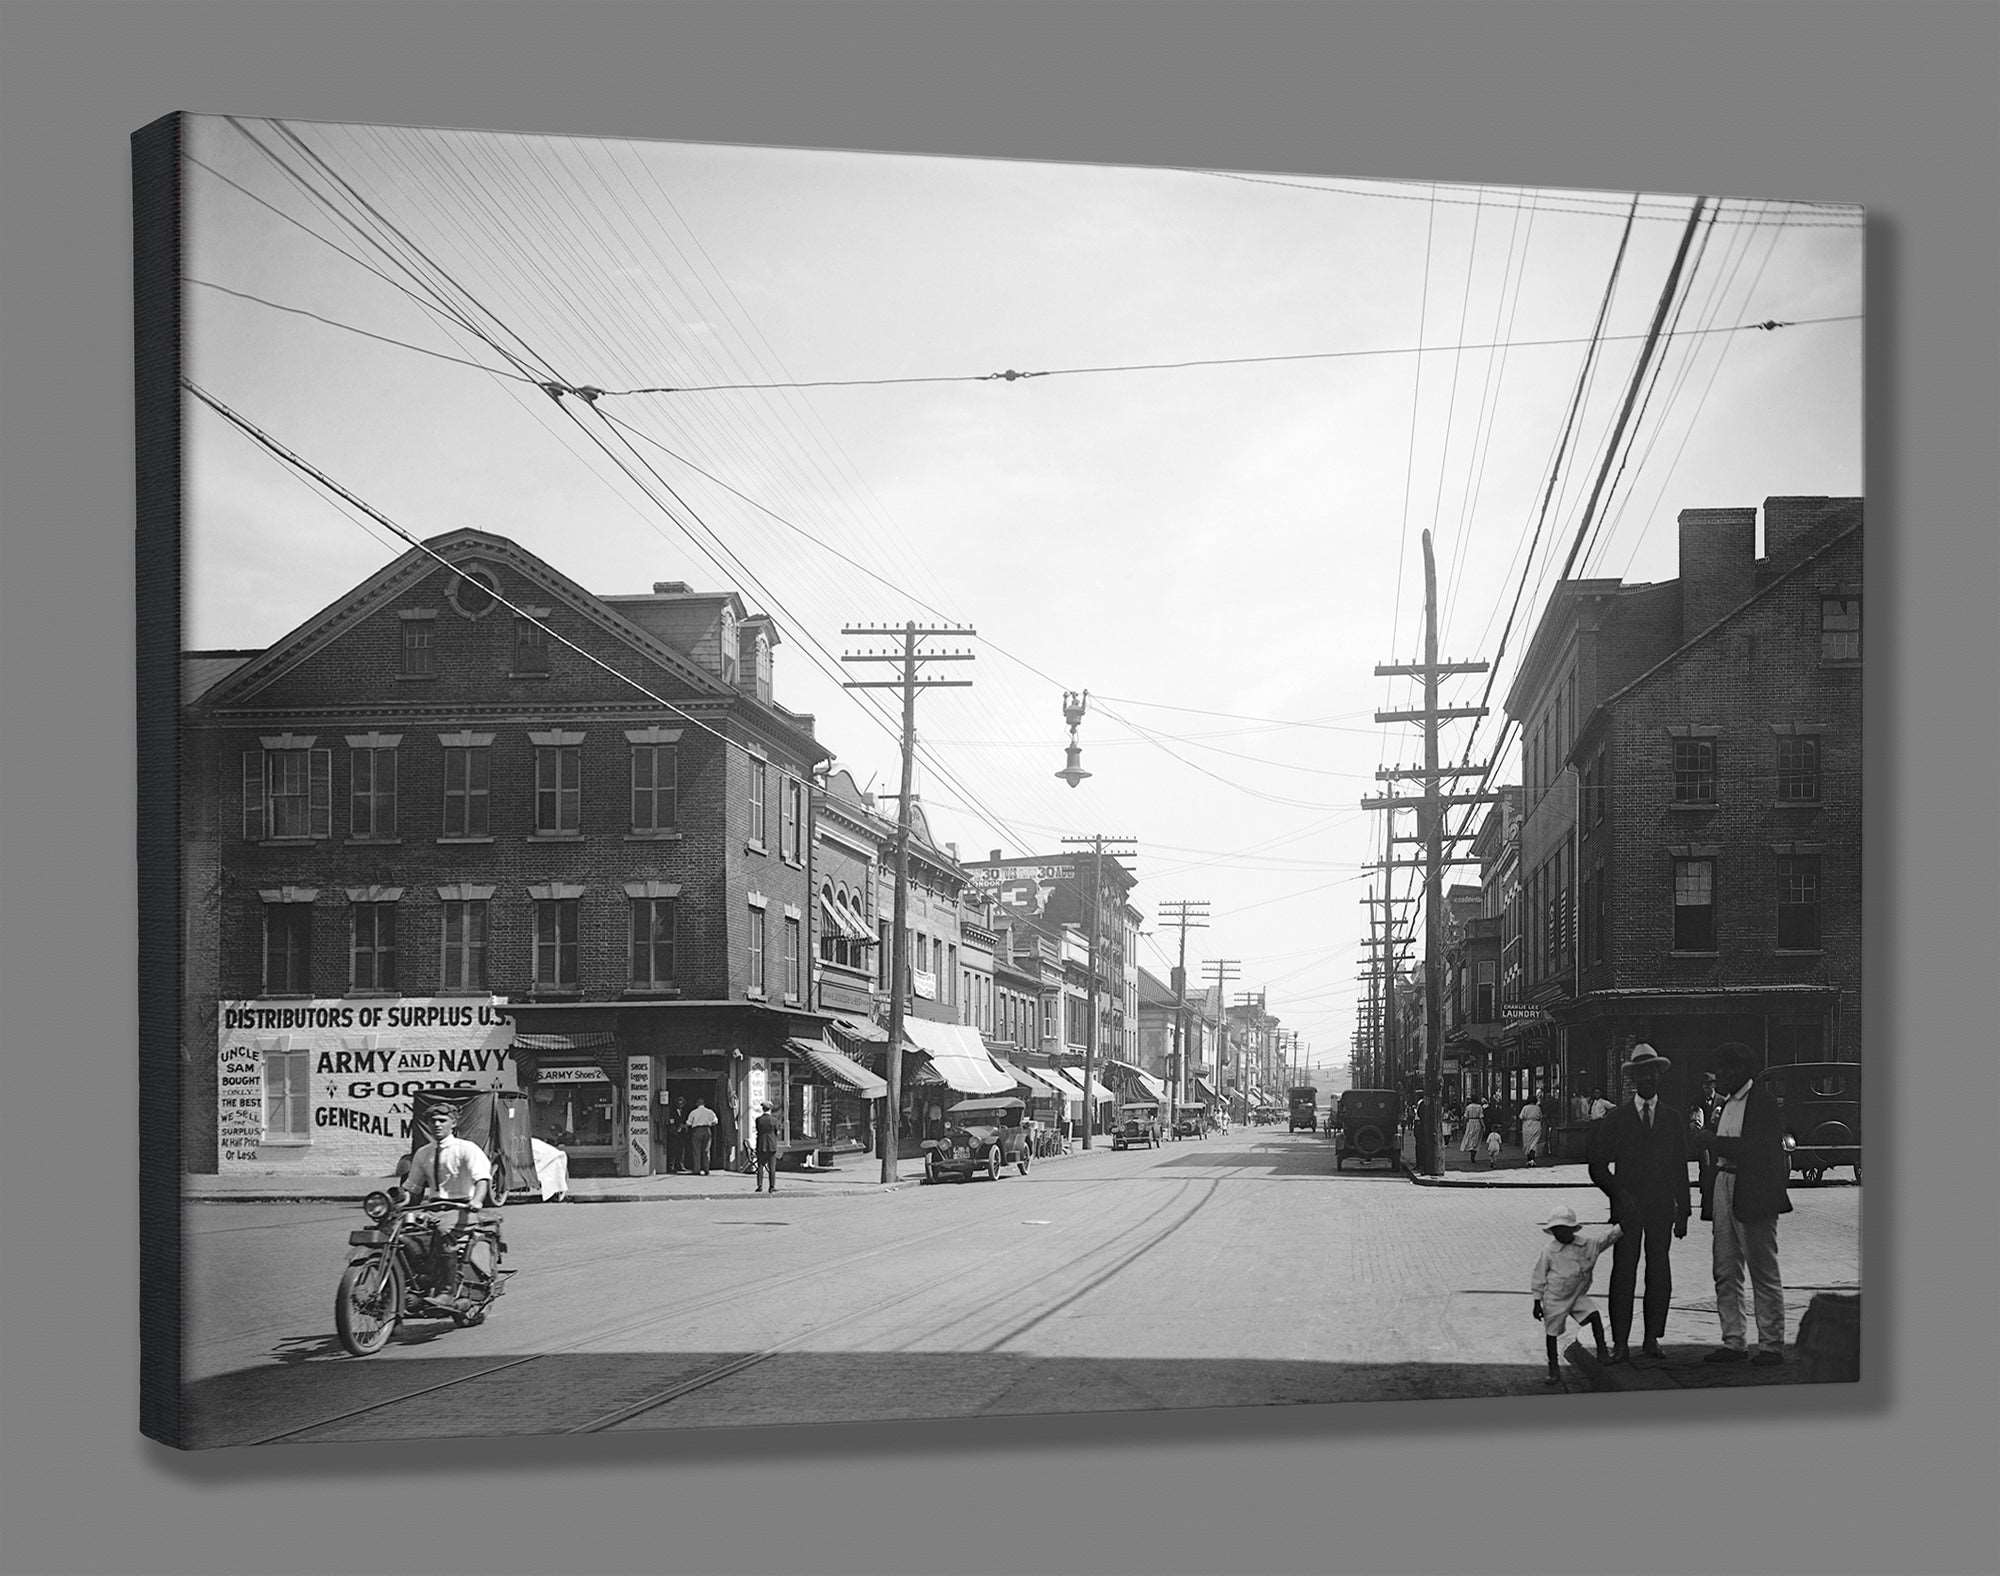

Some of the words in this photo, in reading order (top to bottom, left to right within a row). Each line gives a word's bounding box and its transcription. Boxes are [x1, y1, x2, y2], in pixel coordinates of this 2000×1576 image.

[1037, 866, 1055, 878] 30
[225, 1007, 354, 1029] DISTRIBUTORS
[359, 1007, 382, 1028] OF
[387, 1006, 473, 1027] SURPLUS
[478, 1005, 512, 1026] U.S.
[1502, 1010, 1541, 1018] LAUNDRY
[221, 1046, 260, 1062] UNCLE
[317, 1051, 396, 1073] ARMY
[398, 1053, 435, 1069] AND
[438, 1049, 509, 1072] NAVY
[226, 1063, 255, 1073] SAM
[222, 1076, 260, 1086] BOUGHT
[221, 1098, 237, 1107] THE
[239, 1098, 262, 1107] BEST
[388, 1103, 414, 1114] AN
[221, 1112, 234, 1122] WE
[236, 1109, 260, 1123] SELL
[315, 1106, 394, 1138] GENERAL
[225, 1150, 235, 1160] Or
